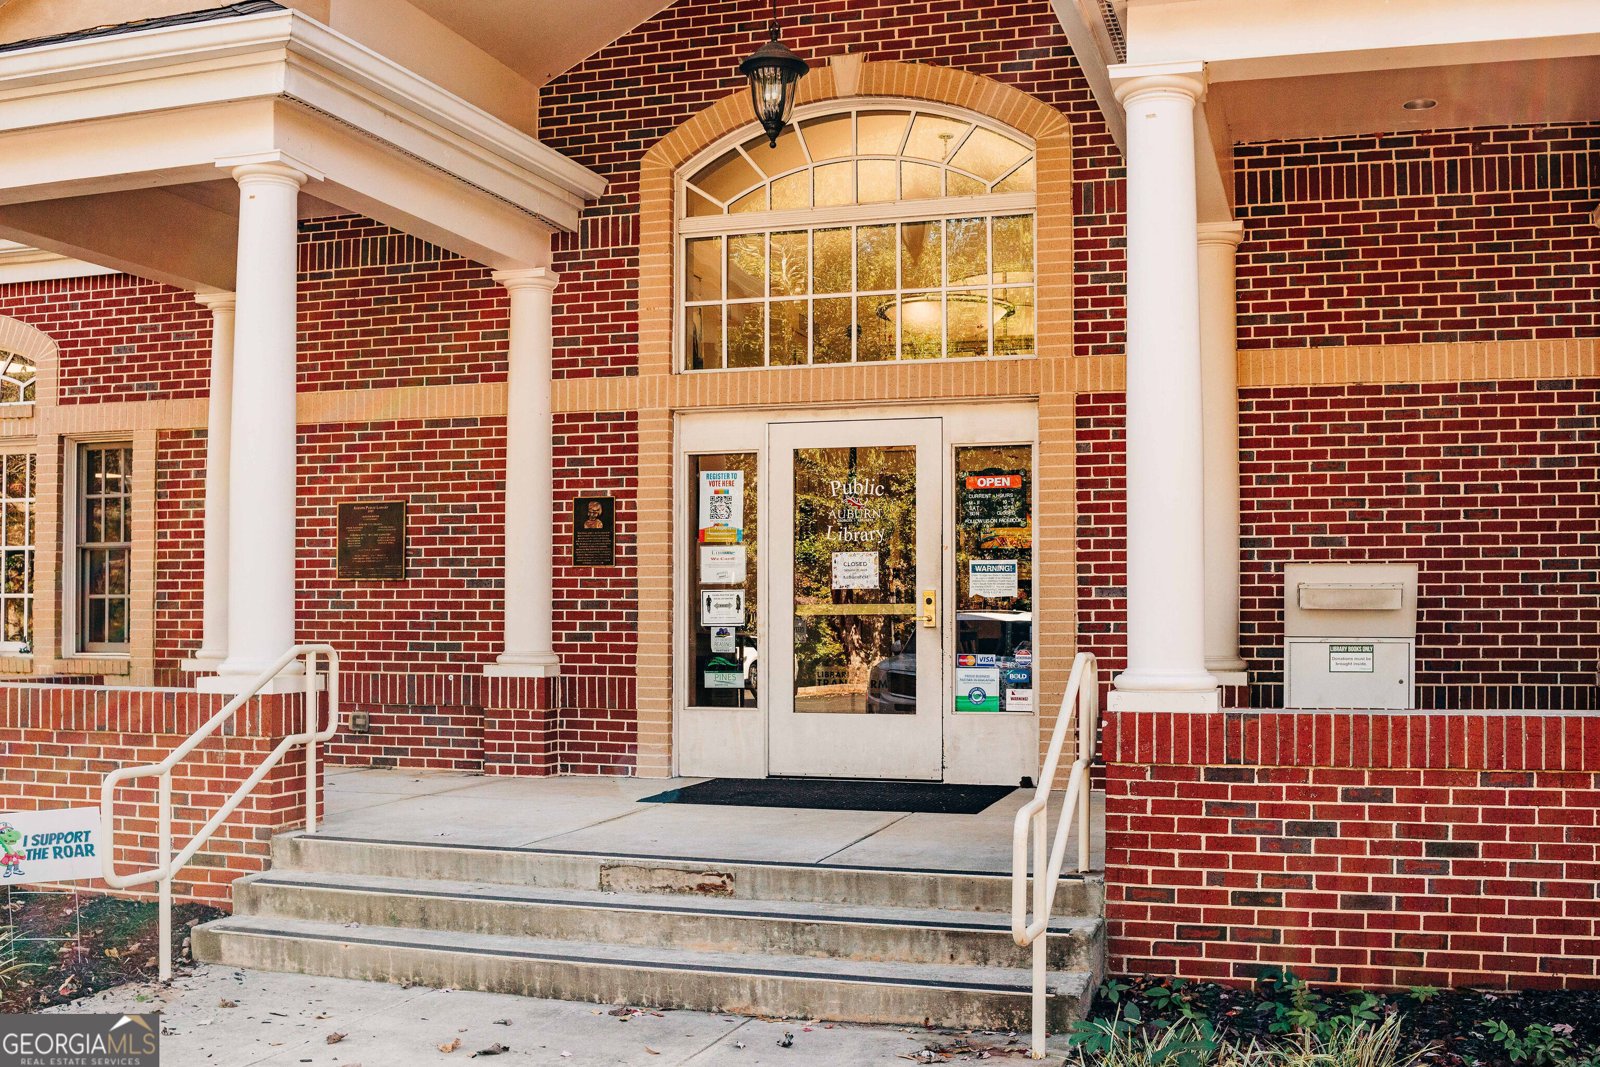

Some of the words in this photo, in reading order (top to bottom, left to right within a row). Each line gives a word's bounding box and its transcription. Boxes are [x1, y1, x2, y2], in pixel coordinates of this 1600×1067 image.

[830, 478, 885, 497] Public
[977, 477, 1011, 487] OPEN
[828, 509, 882, 519] AUBURN
[827, 525, 885, 544] Library
[714, 673, 737, 681] PINES
[22, 835, 28, 847] I
[31, 830, 91, 847] SUPPORT
[26, 847, 49, 861] THE
[52, 843, 96, 860] ROAR
